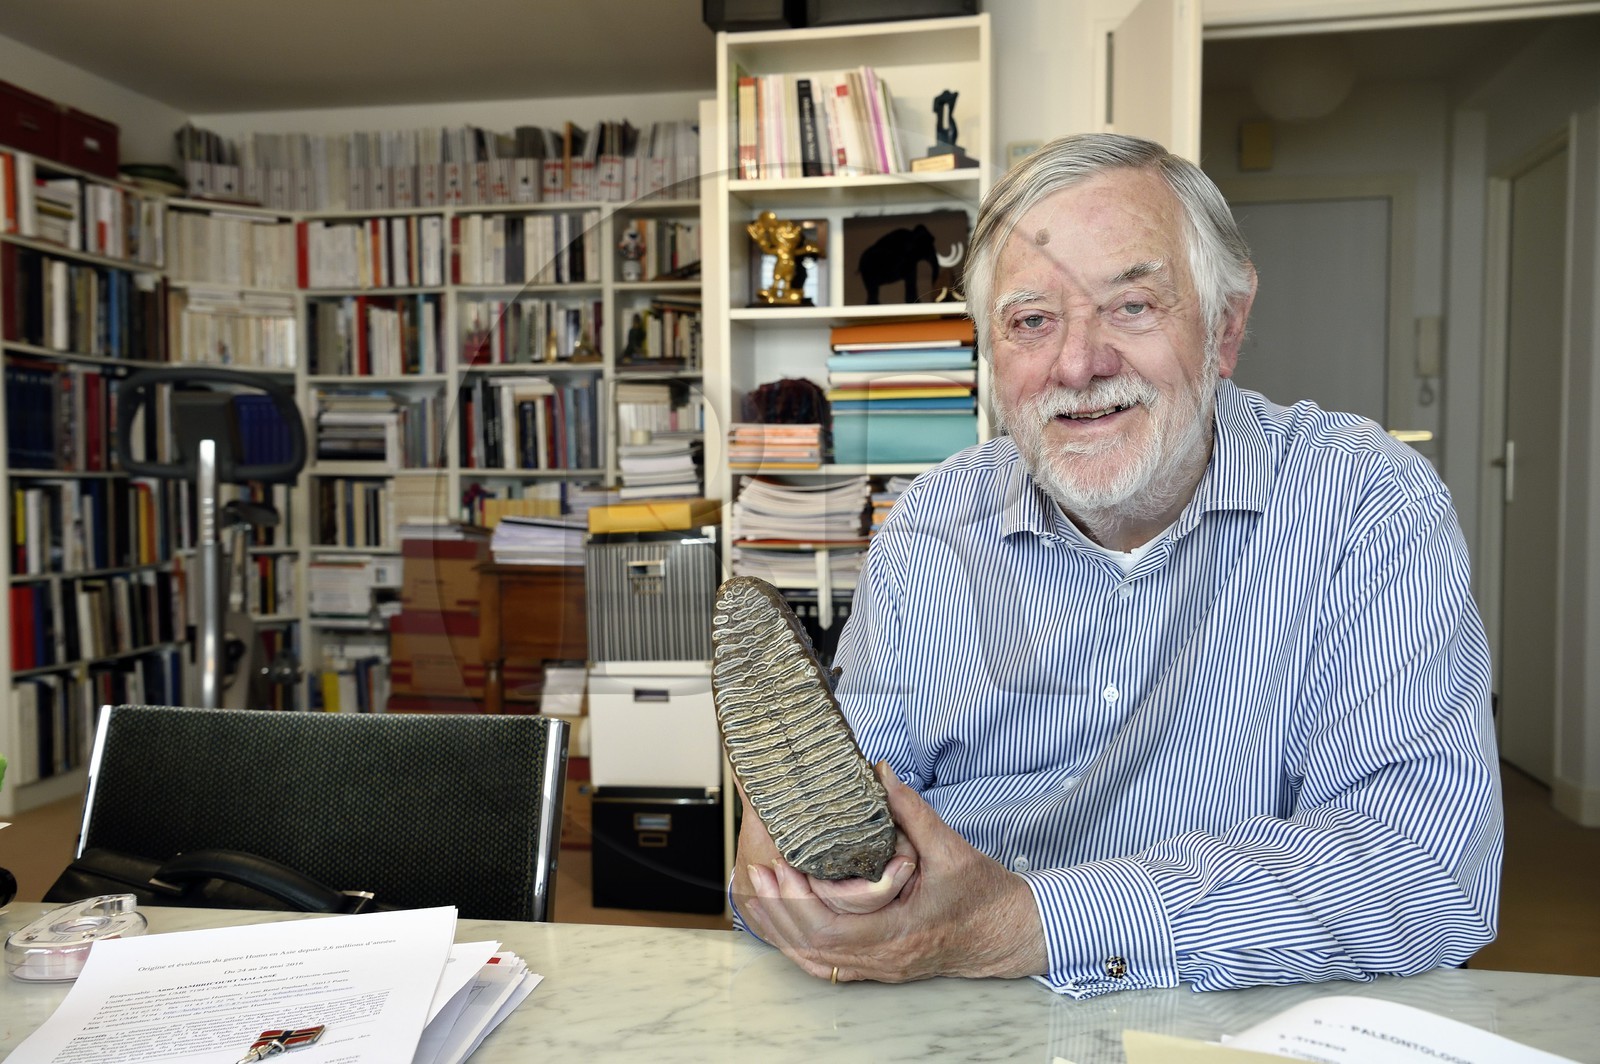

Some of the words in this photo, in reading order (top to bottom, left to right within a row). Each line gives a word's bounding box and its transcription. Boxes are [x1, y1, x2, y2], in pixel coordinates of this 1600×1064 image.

[138, 964, 166, 972] Origine
[176, 959, 210, 967] évolution
[296, 946, 321, 954] depuis
[334, 941, 364, 949] millions
[364, 938, 396, 946] d'années
[108, 990, 150, 999] Responsable
[175, 978, 236, 990] DAMBRICOURT
